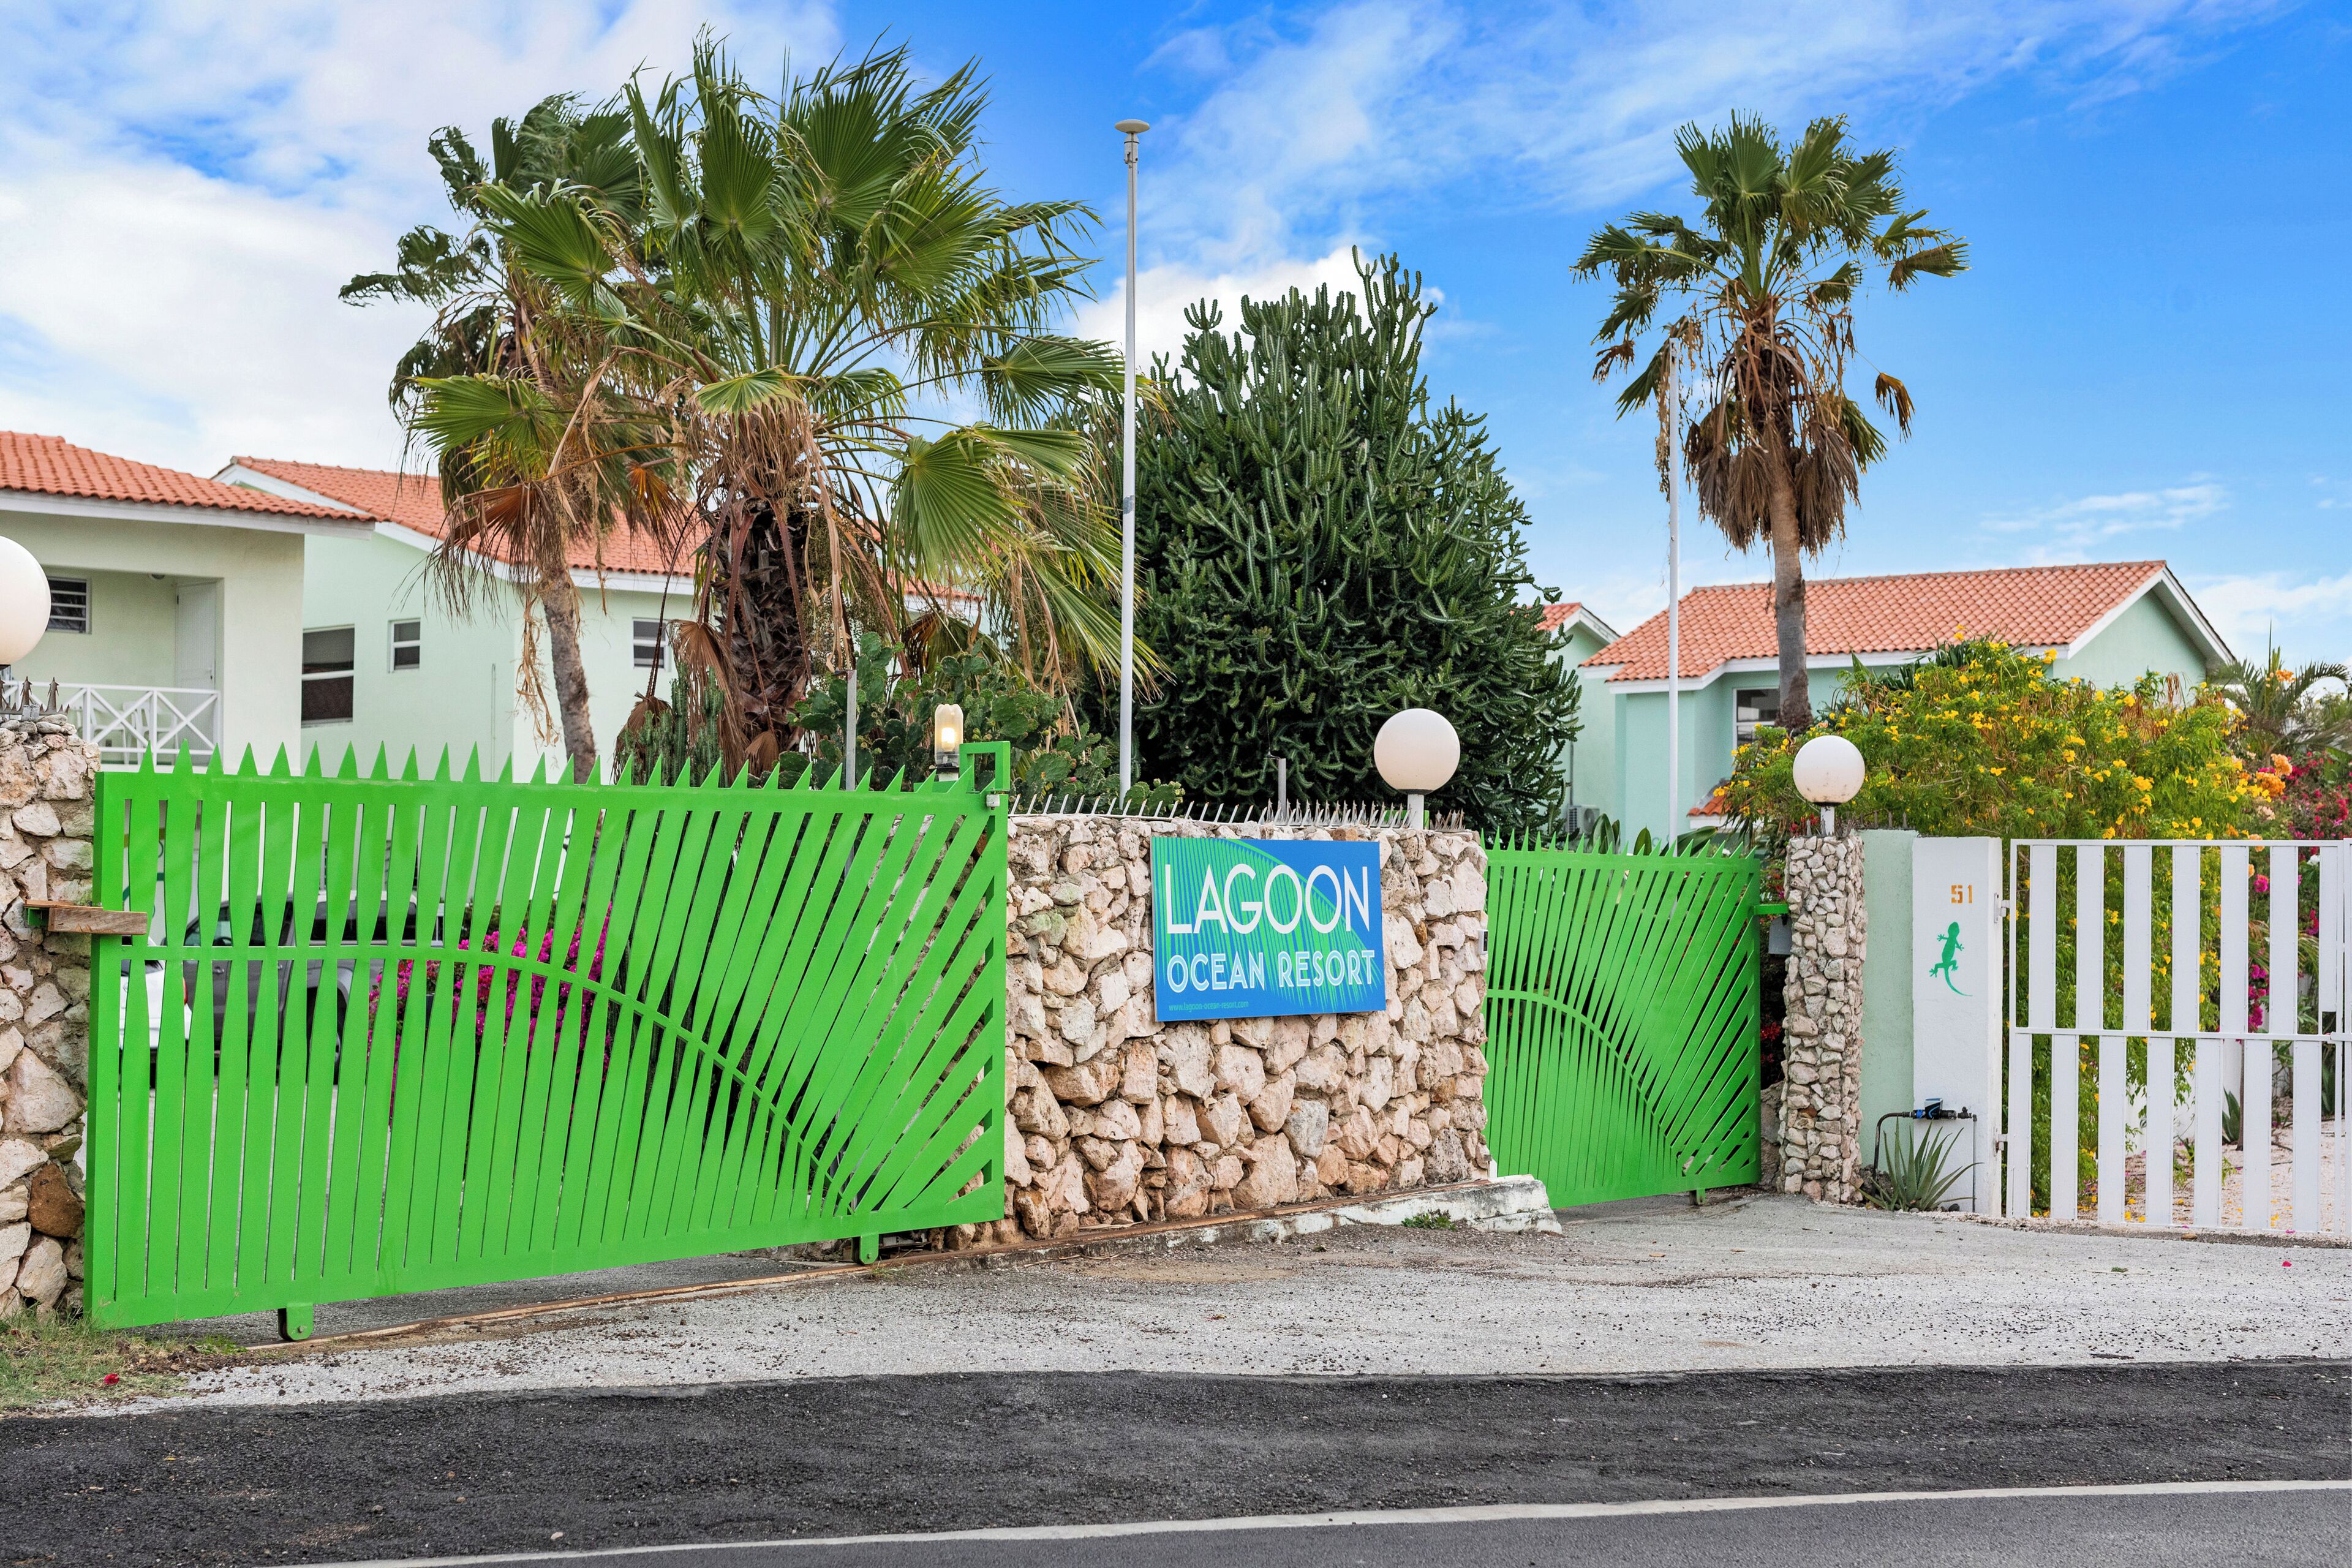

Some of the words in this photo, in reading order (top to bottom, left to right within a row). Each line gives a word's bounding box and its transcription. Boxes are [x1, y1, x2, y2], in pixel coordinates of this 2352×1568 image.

[1165, 863, 1370, 935] LAGOON
[1951, 884, 1972, 903] 51
[1167, 949, 1265, 993] OCEAN
[1278, 949, 1375, 987] RESORT
[1168, 1000, 1249, 1012] www.lagoon-ocean-resort.com
